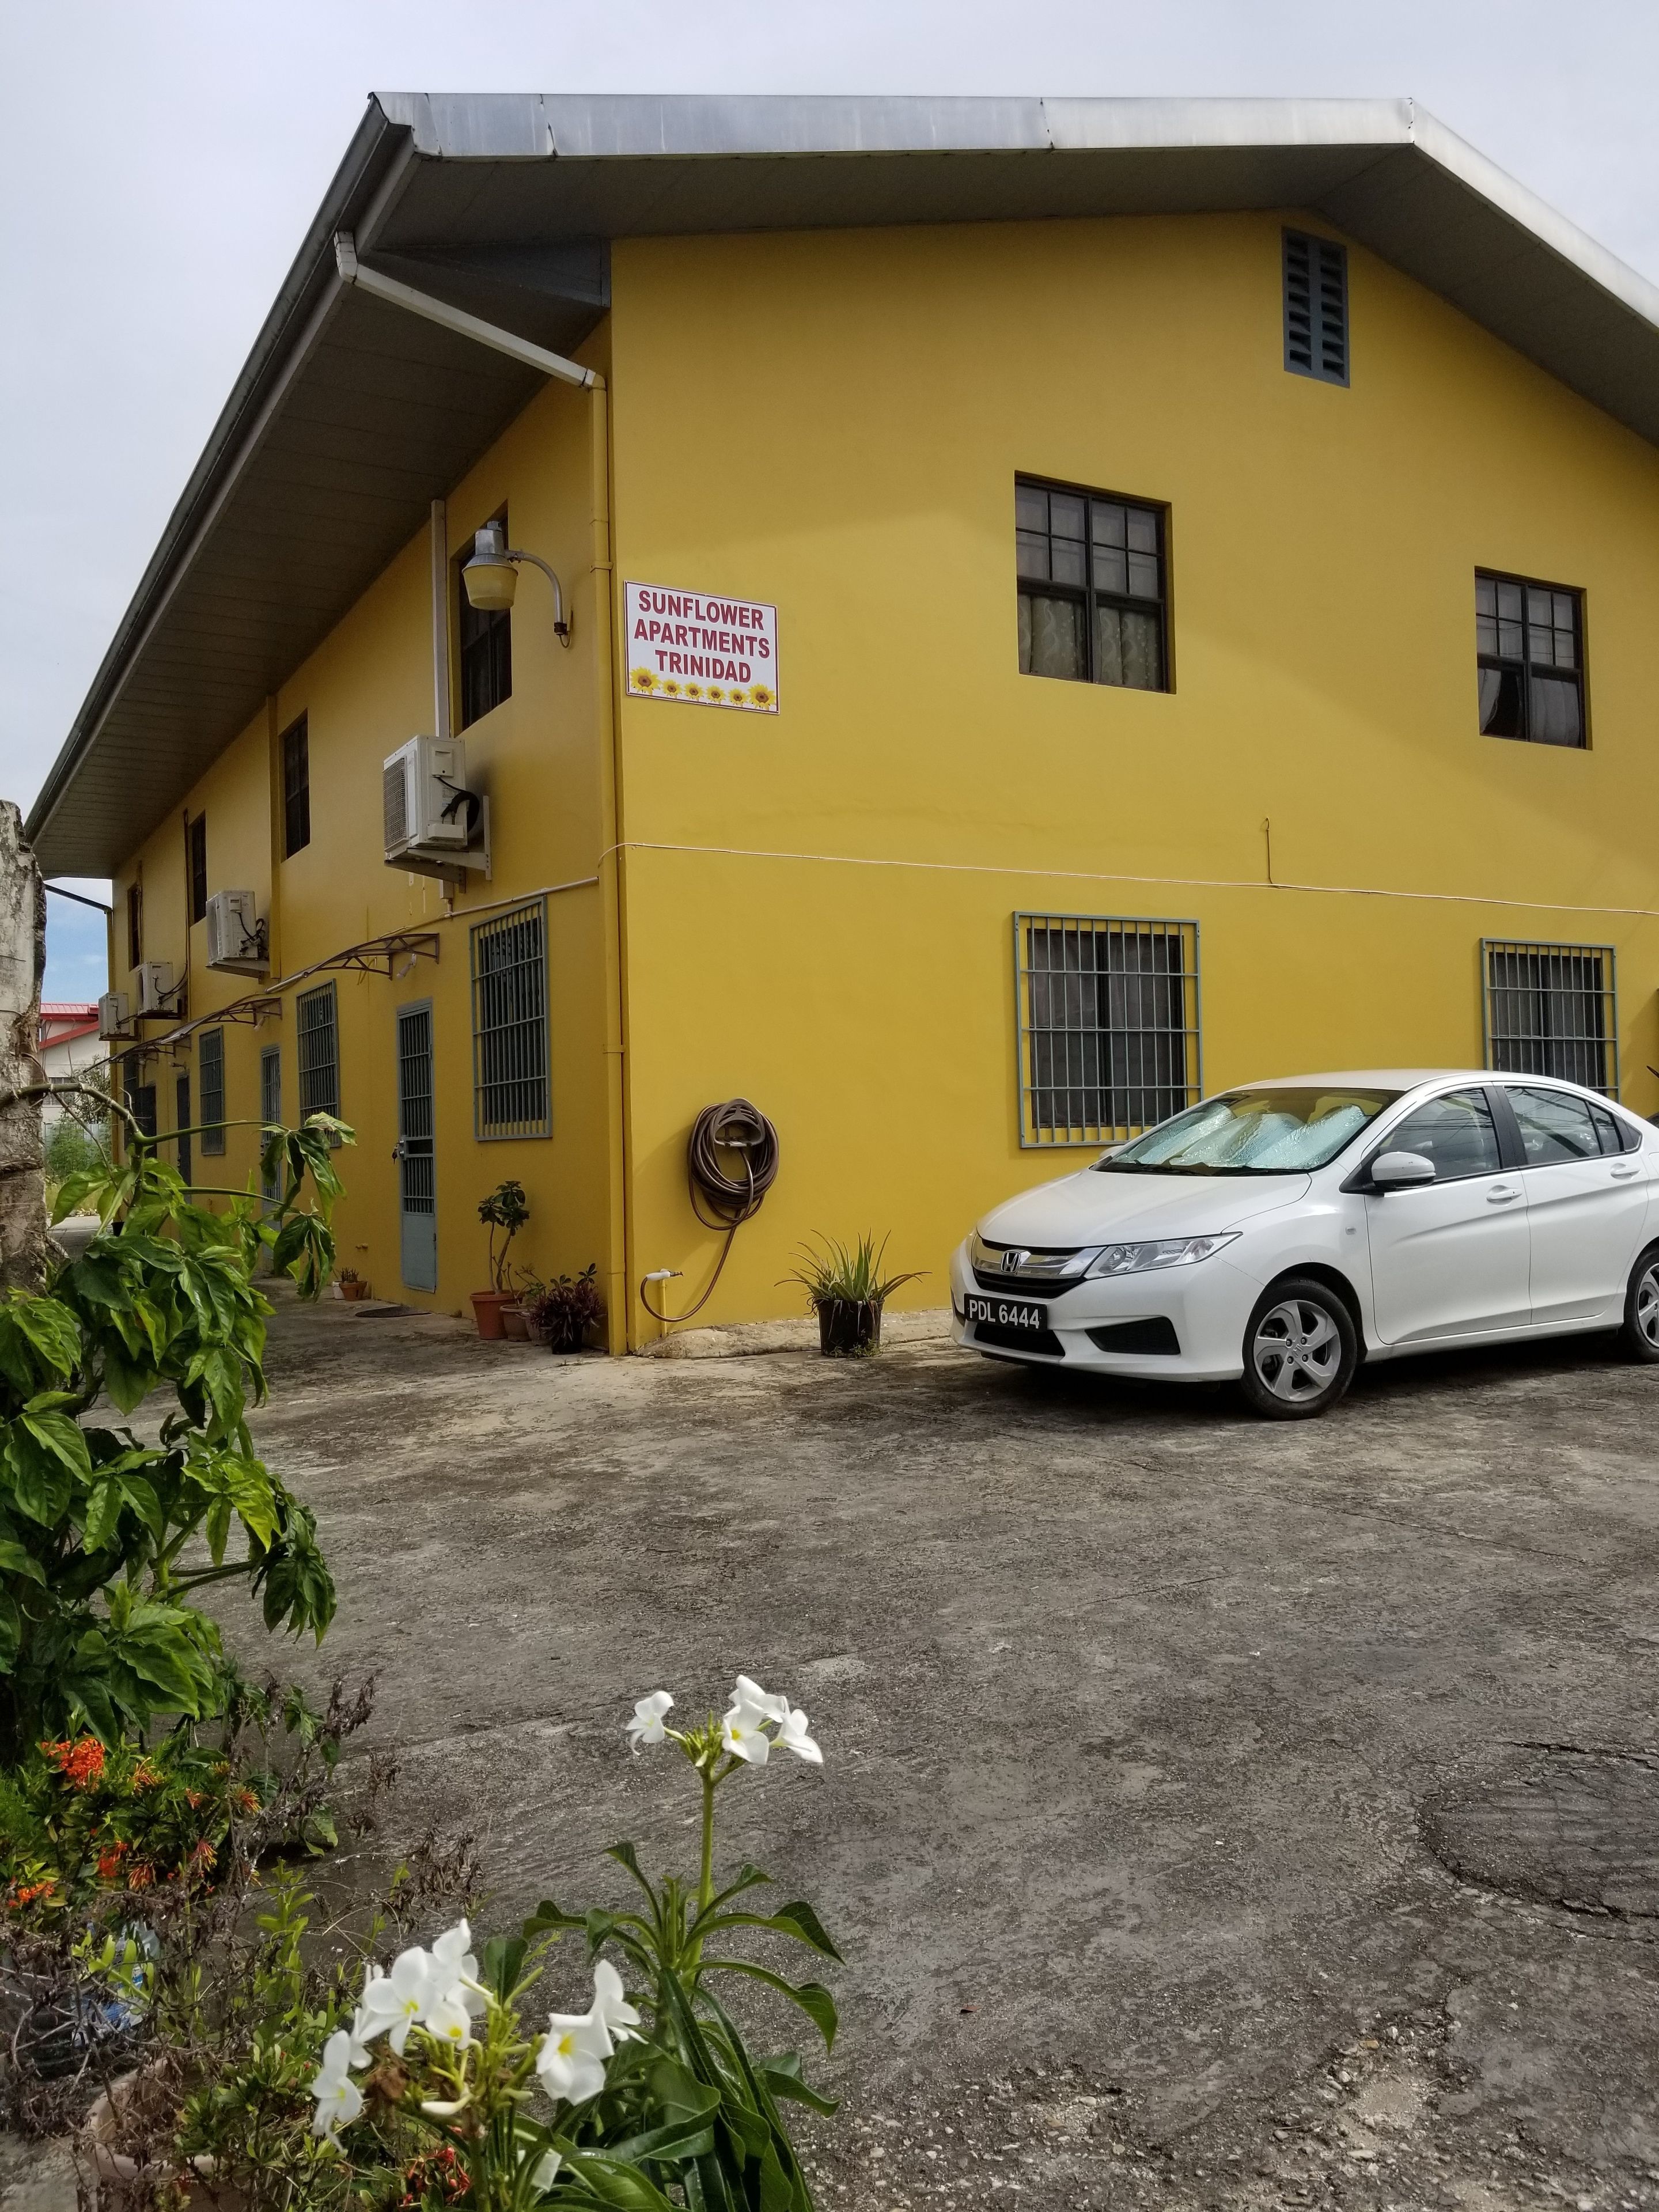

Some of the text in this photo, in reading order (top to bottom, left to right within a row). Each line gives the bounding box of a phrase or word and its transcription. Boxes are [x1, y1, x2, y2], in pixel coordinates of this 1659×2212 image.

[639, 590, 764, 630] SUNFLOWER
[634, 619, 770, 658] APARTMENTS
[655, 650, 751, 683] TRINIDAD
[969, 1300, 1040, 1329] PDL 6444
